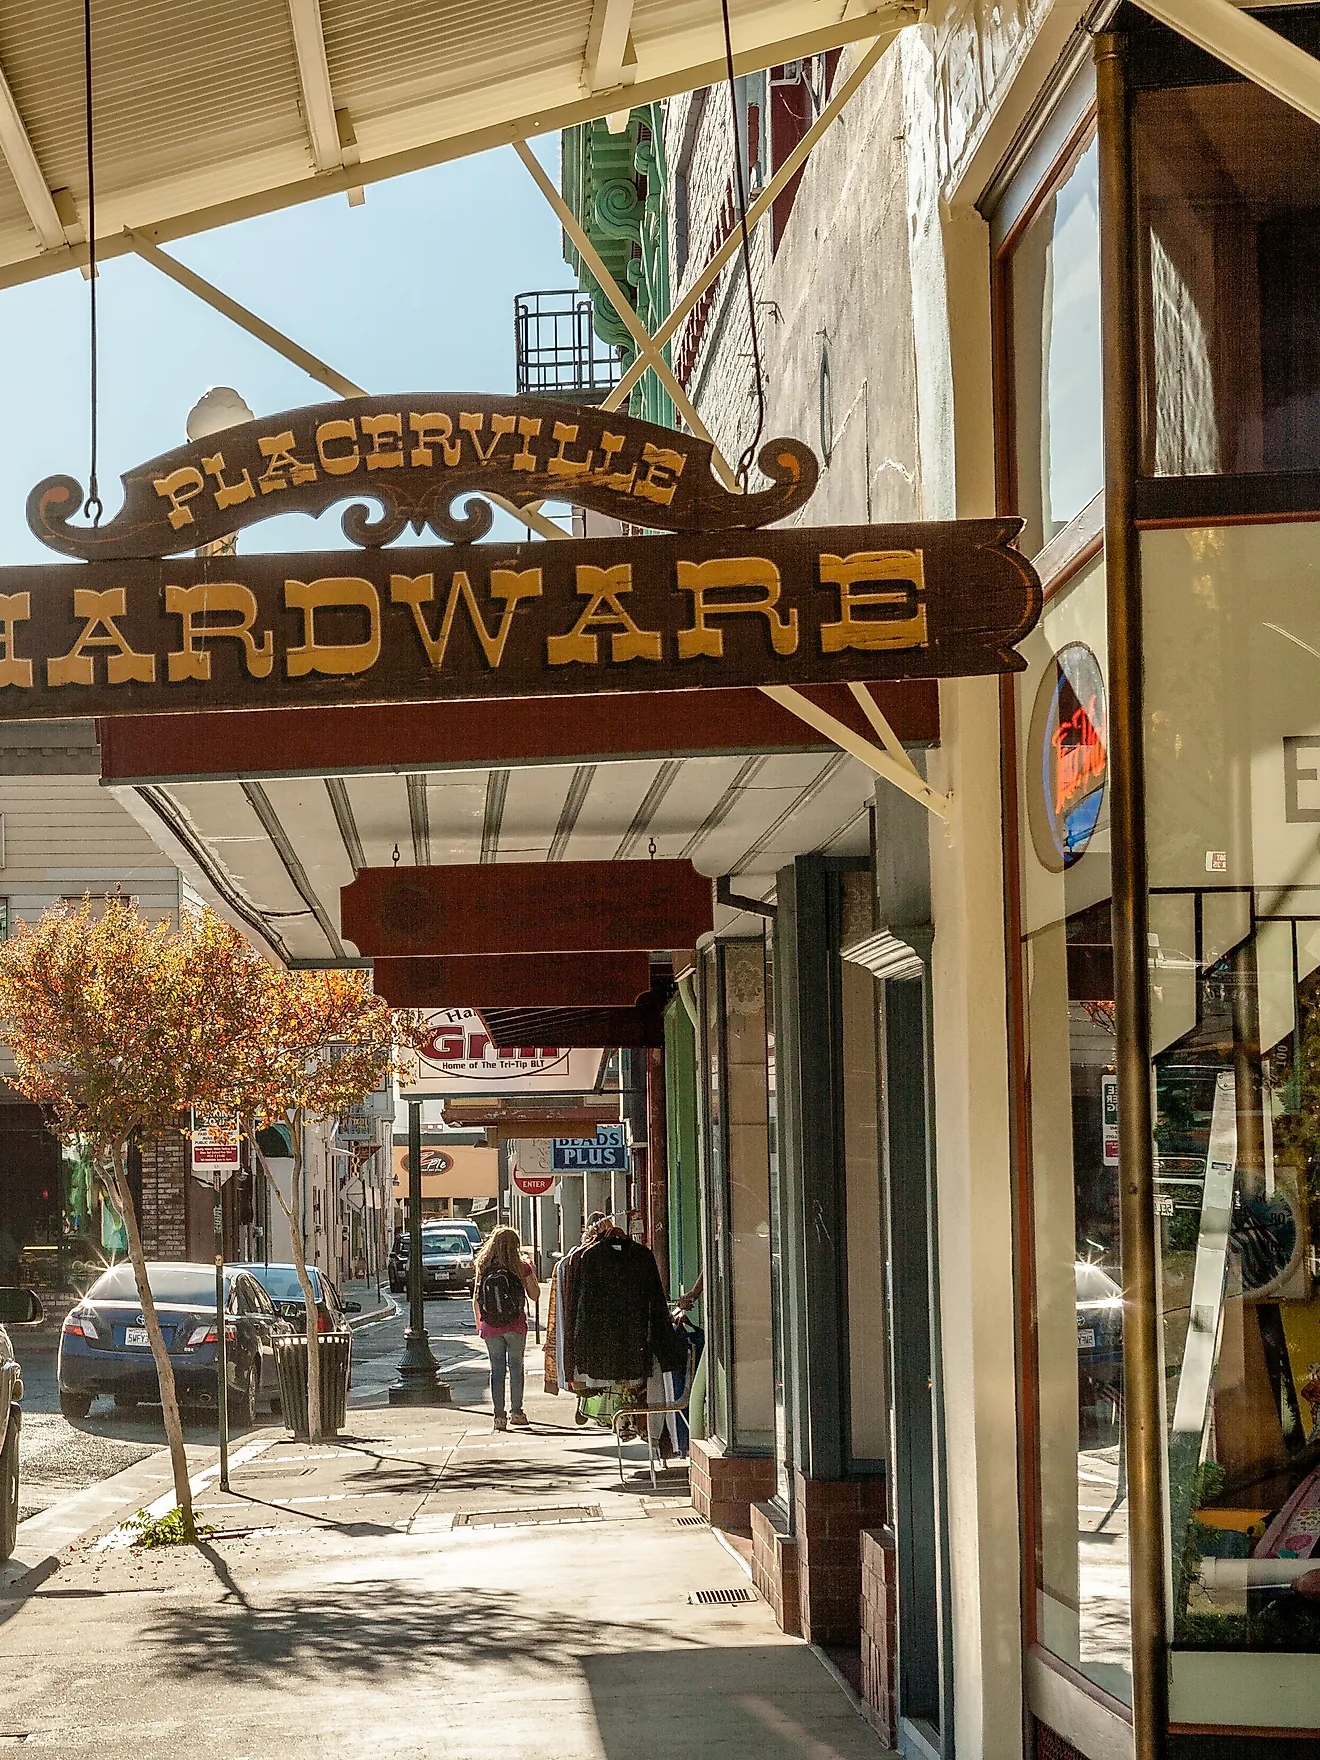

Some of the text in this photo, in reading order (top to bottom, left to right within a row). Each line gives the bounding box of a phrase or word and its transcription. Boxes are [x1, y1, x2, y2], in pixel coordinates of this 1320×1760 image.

[151, 412, 686, 532] PLACERVILLE
[442, 1060, 545, 1070] Home of The Tri-Tip BLT
[564, 1149, 616, 1165] PLUS
[522, 1180, 546, 1188] ENTER
